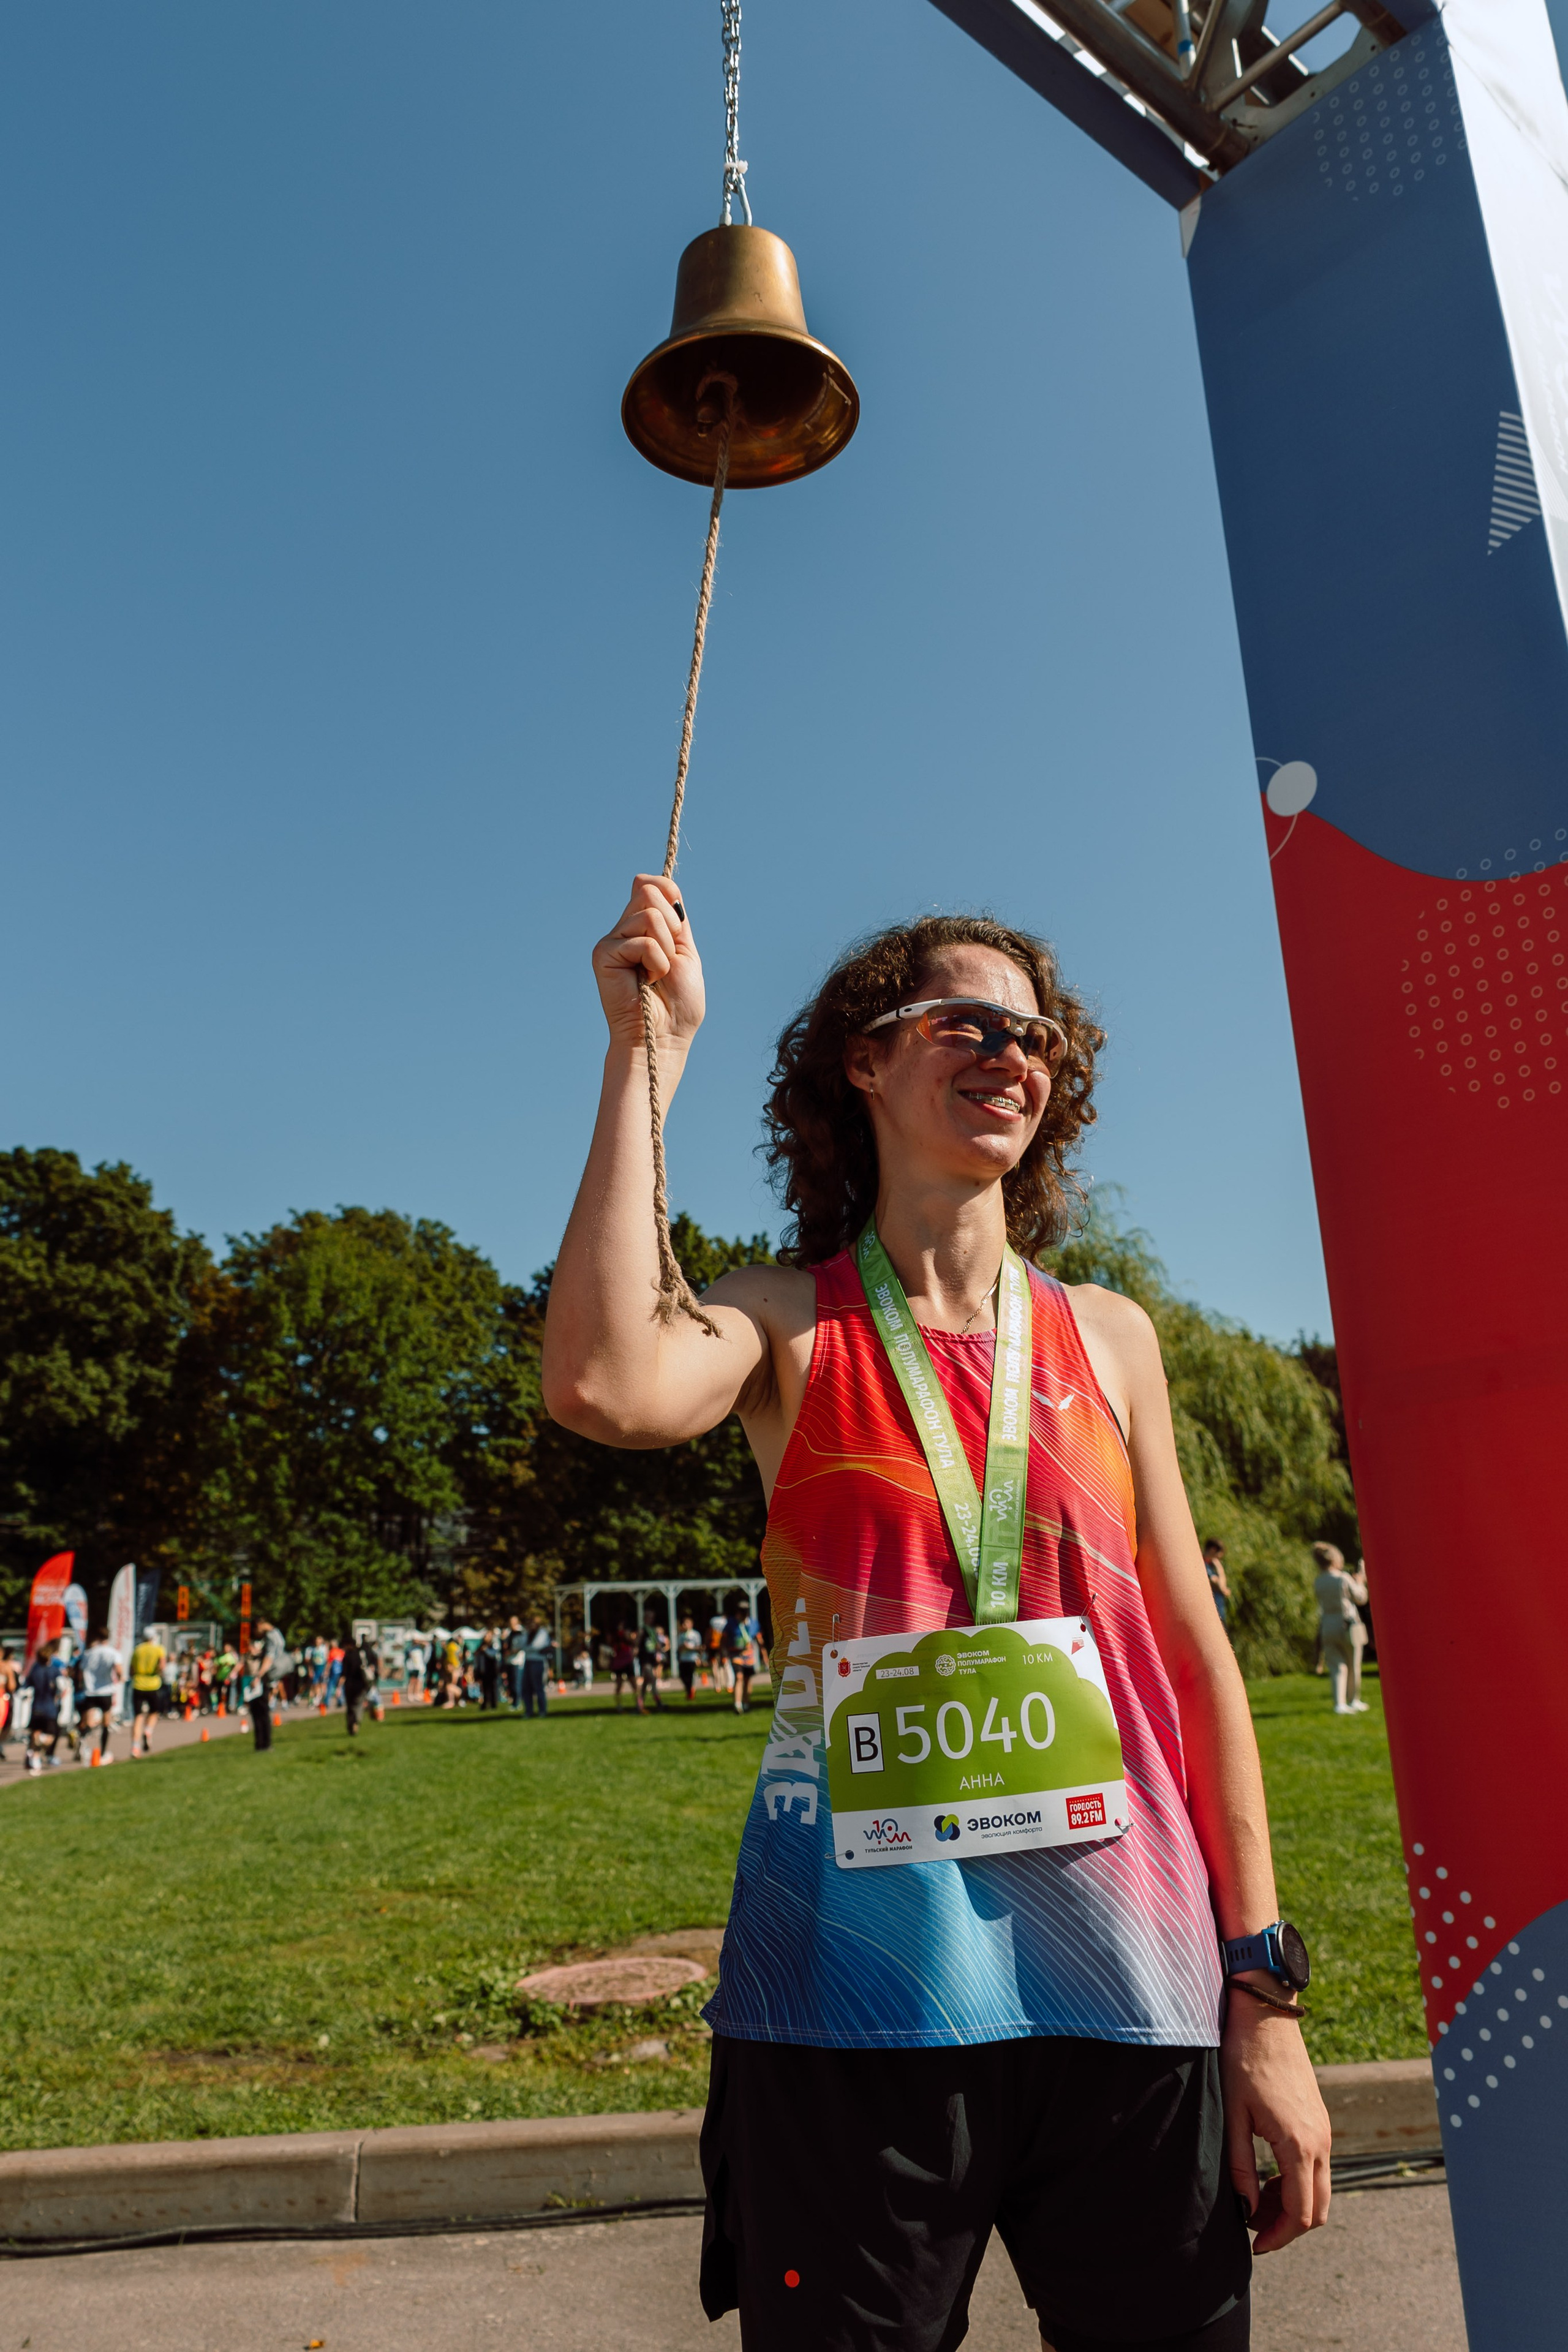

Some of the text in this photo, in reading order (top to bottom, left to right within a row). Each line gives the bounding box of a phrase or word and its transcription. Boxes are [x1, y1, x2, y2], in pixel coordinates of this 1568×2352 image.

[1006, 1293, 1022, 1384] ПОЛУМАРАФОН
[875, 1283, 955, 1469] ЭВОКОМ ПОЛУМАРАФОН ТУЛА
[1001, 1387, 1020, 1441] ЭВОКОМ
[954, 1502, 980, 1580] 23-24.0.
[990, 1562, 1008, 1608] 10 КМ
[957, 1650, 990, 1659] ЭВОКОМ
[957, 1656, 1006, 1667] ПОЛУМАРАФОН
[1022, 1654, 1034, 1665] 10
[881, 1667, 914, 1678] 23-24.08
[895, 1692, 1055, 1764] 5040
[960, 1773, 1005, 1790] АННА
[1069, 1800, 1101, 1812] ГОРДОСТЬ
[967, 1811, 1042, 1831] ЭВОКОМ
[1071, 1809, 1103, 1825] 89.2 FM
[981, 1826, 1042, 1839] эволюция комфорта
